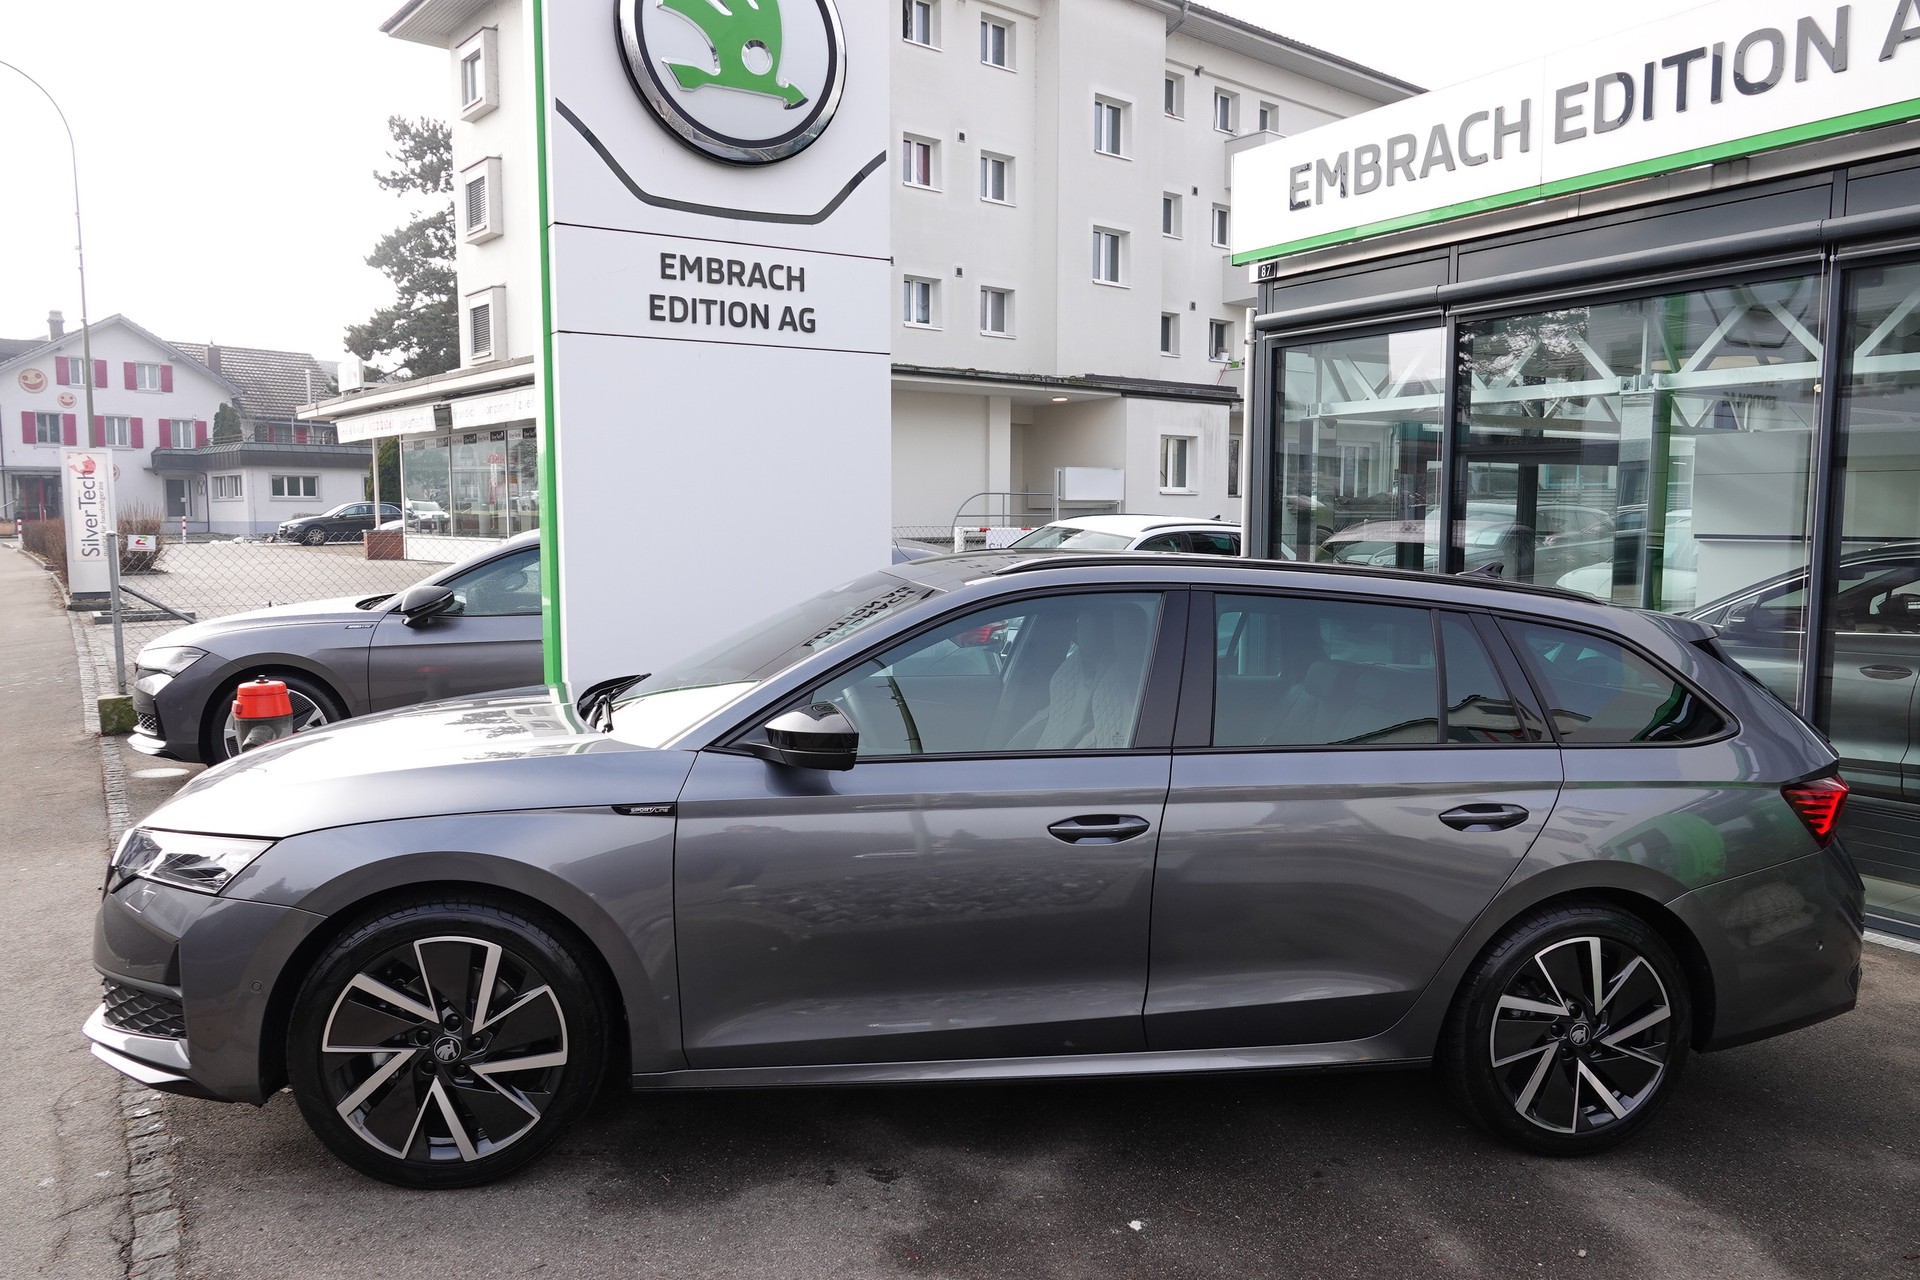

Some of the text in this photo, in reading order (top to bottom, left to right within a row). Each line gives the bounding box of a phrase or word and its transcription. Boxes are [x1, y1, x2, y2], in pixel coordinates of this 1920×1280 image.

[1289, 98, 1531, 212] EMBRACH
[1554, 4, 1850, 146] EDITION
[659, 252, 805, 292] EMBRACH
[1261, 265, 1271, 278] 87
[649, 294, 816, 333] EDITION AG
